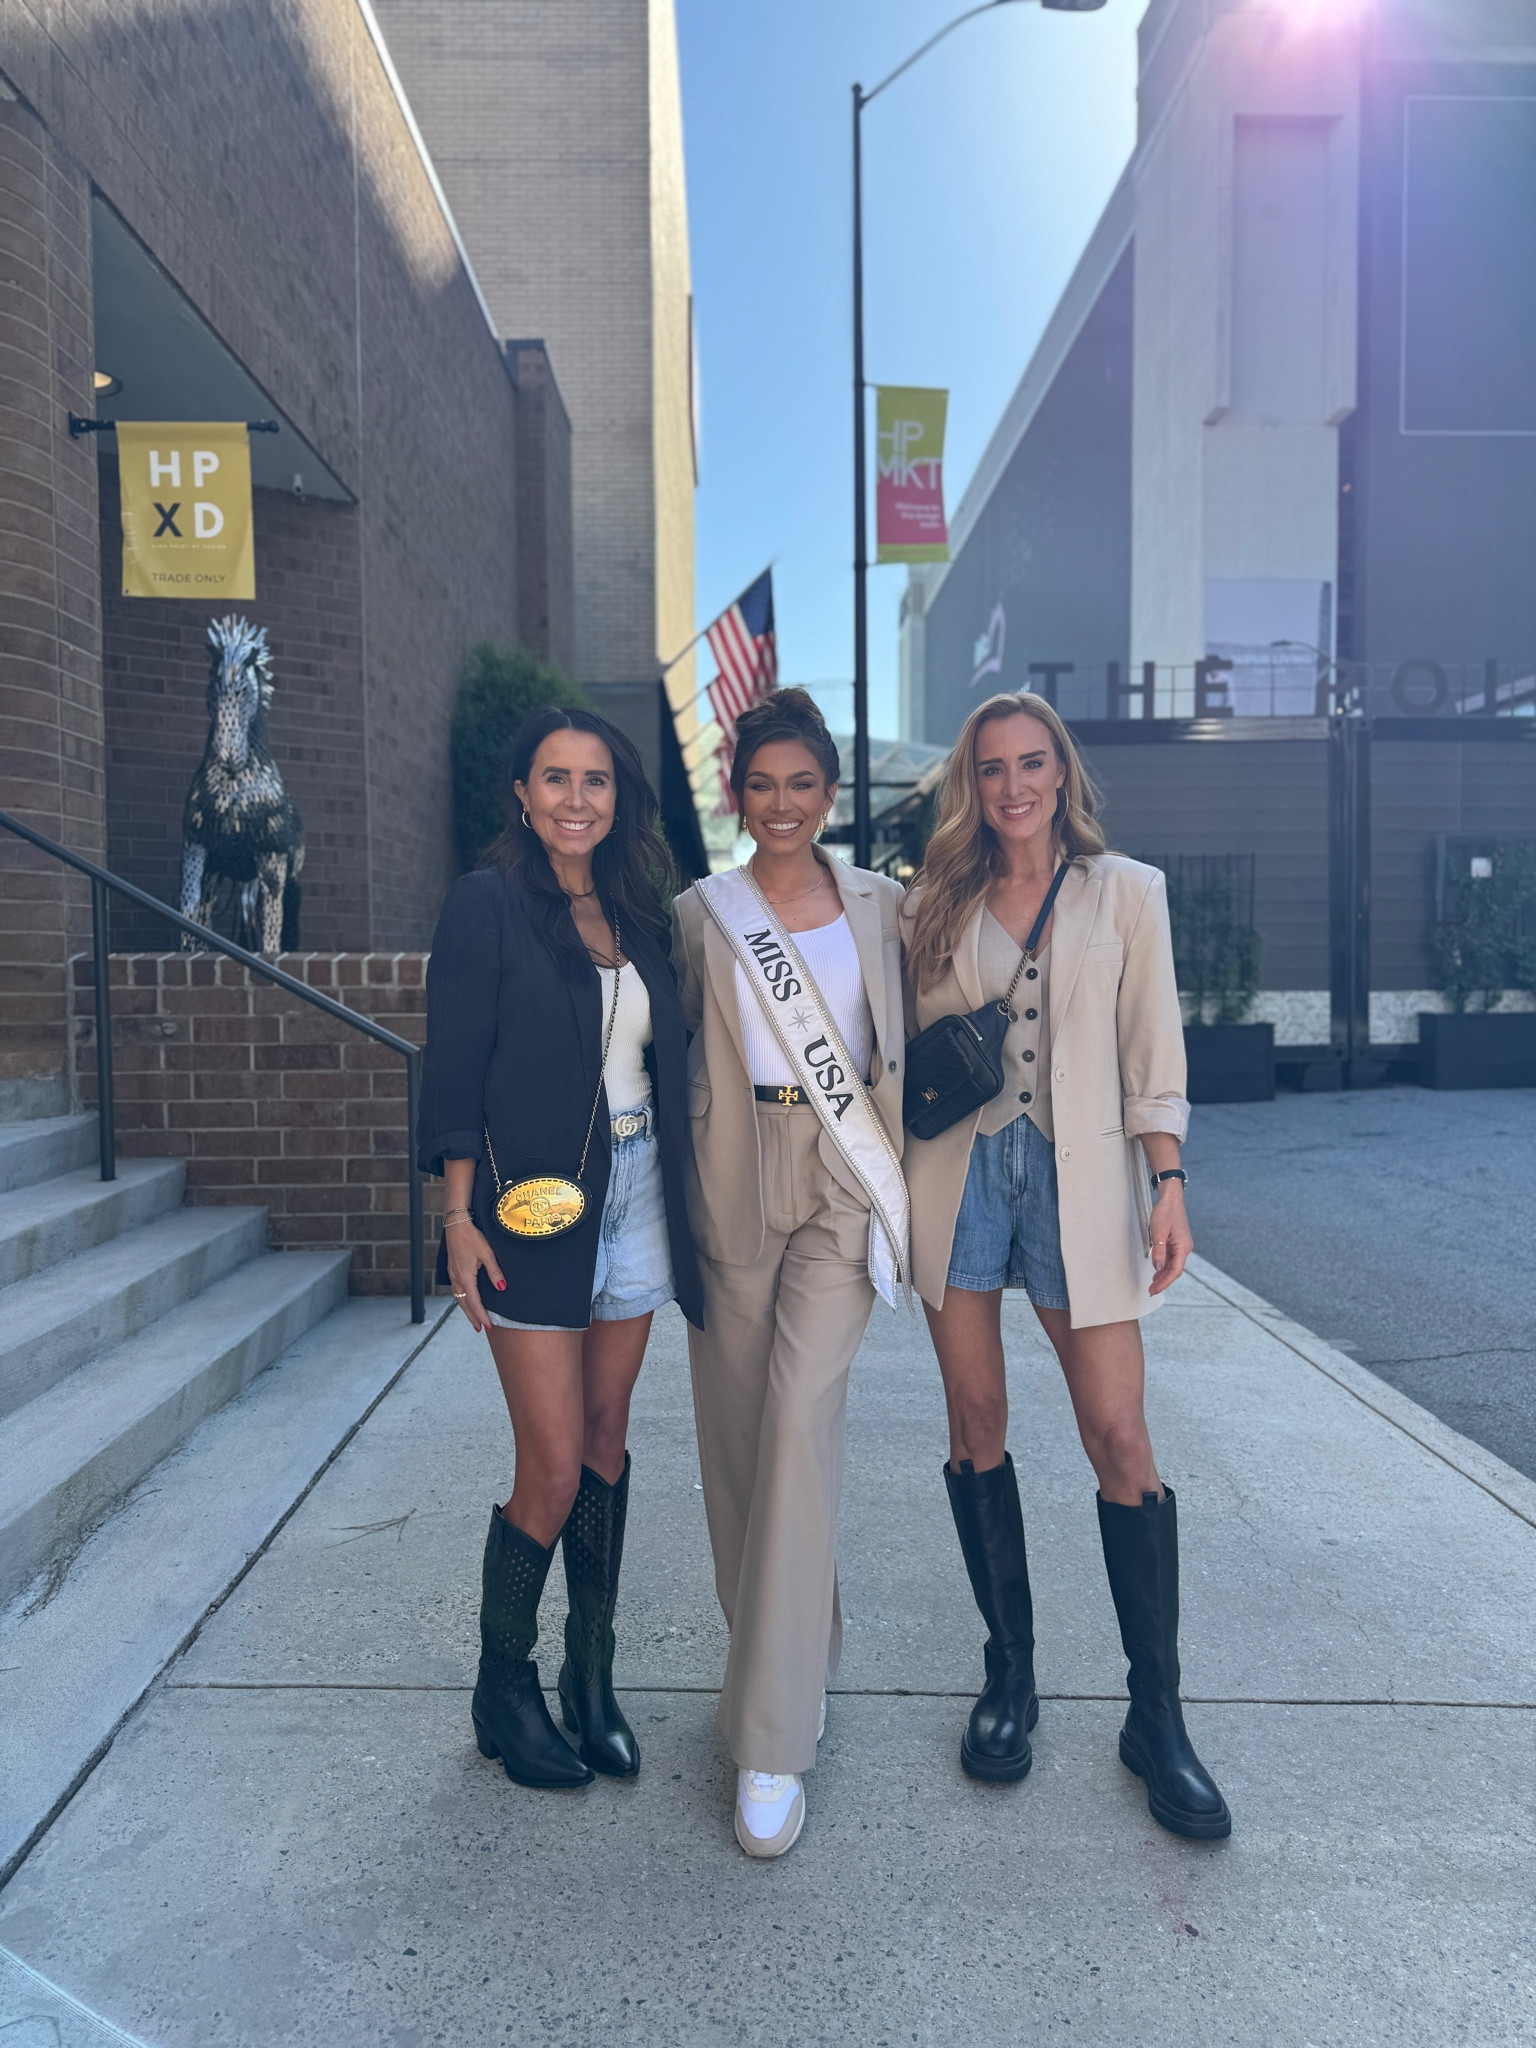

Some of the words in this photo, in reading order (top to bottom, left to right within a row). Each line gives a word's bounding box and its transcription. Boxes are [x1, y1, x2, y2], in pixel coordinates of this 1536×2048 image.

[152, 572, 192, 583] TRADE
[194, 573, 227, 583] ONLY
[1028, 660, 1234, 720] THE
[743, 928, 802, 1002] MISS
[803, 1034, 855, 1122] USA
[515, 1185, 563, 1202] CHANEL
